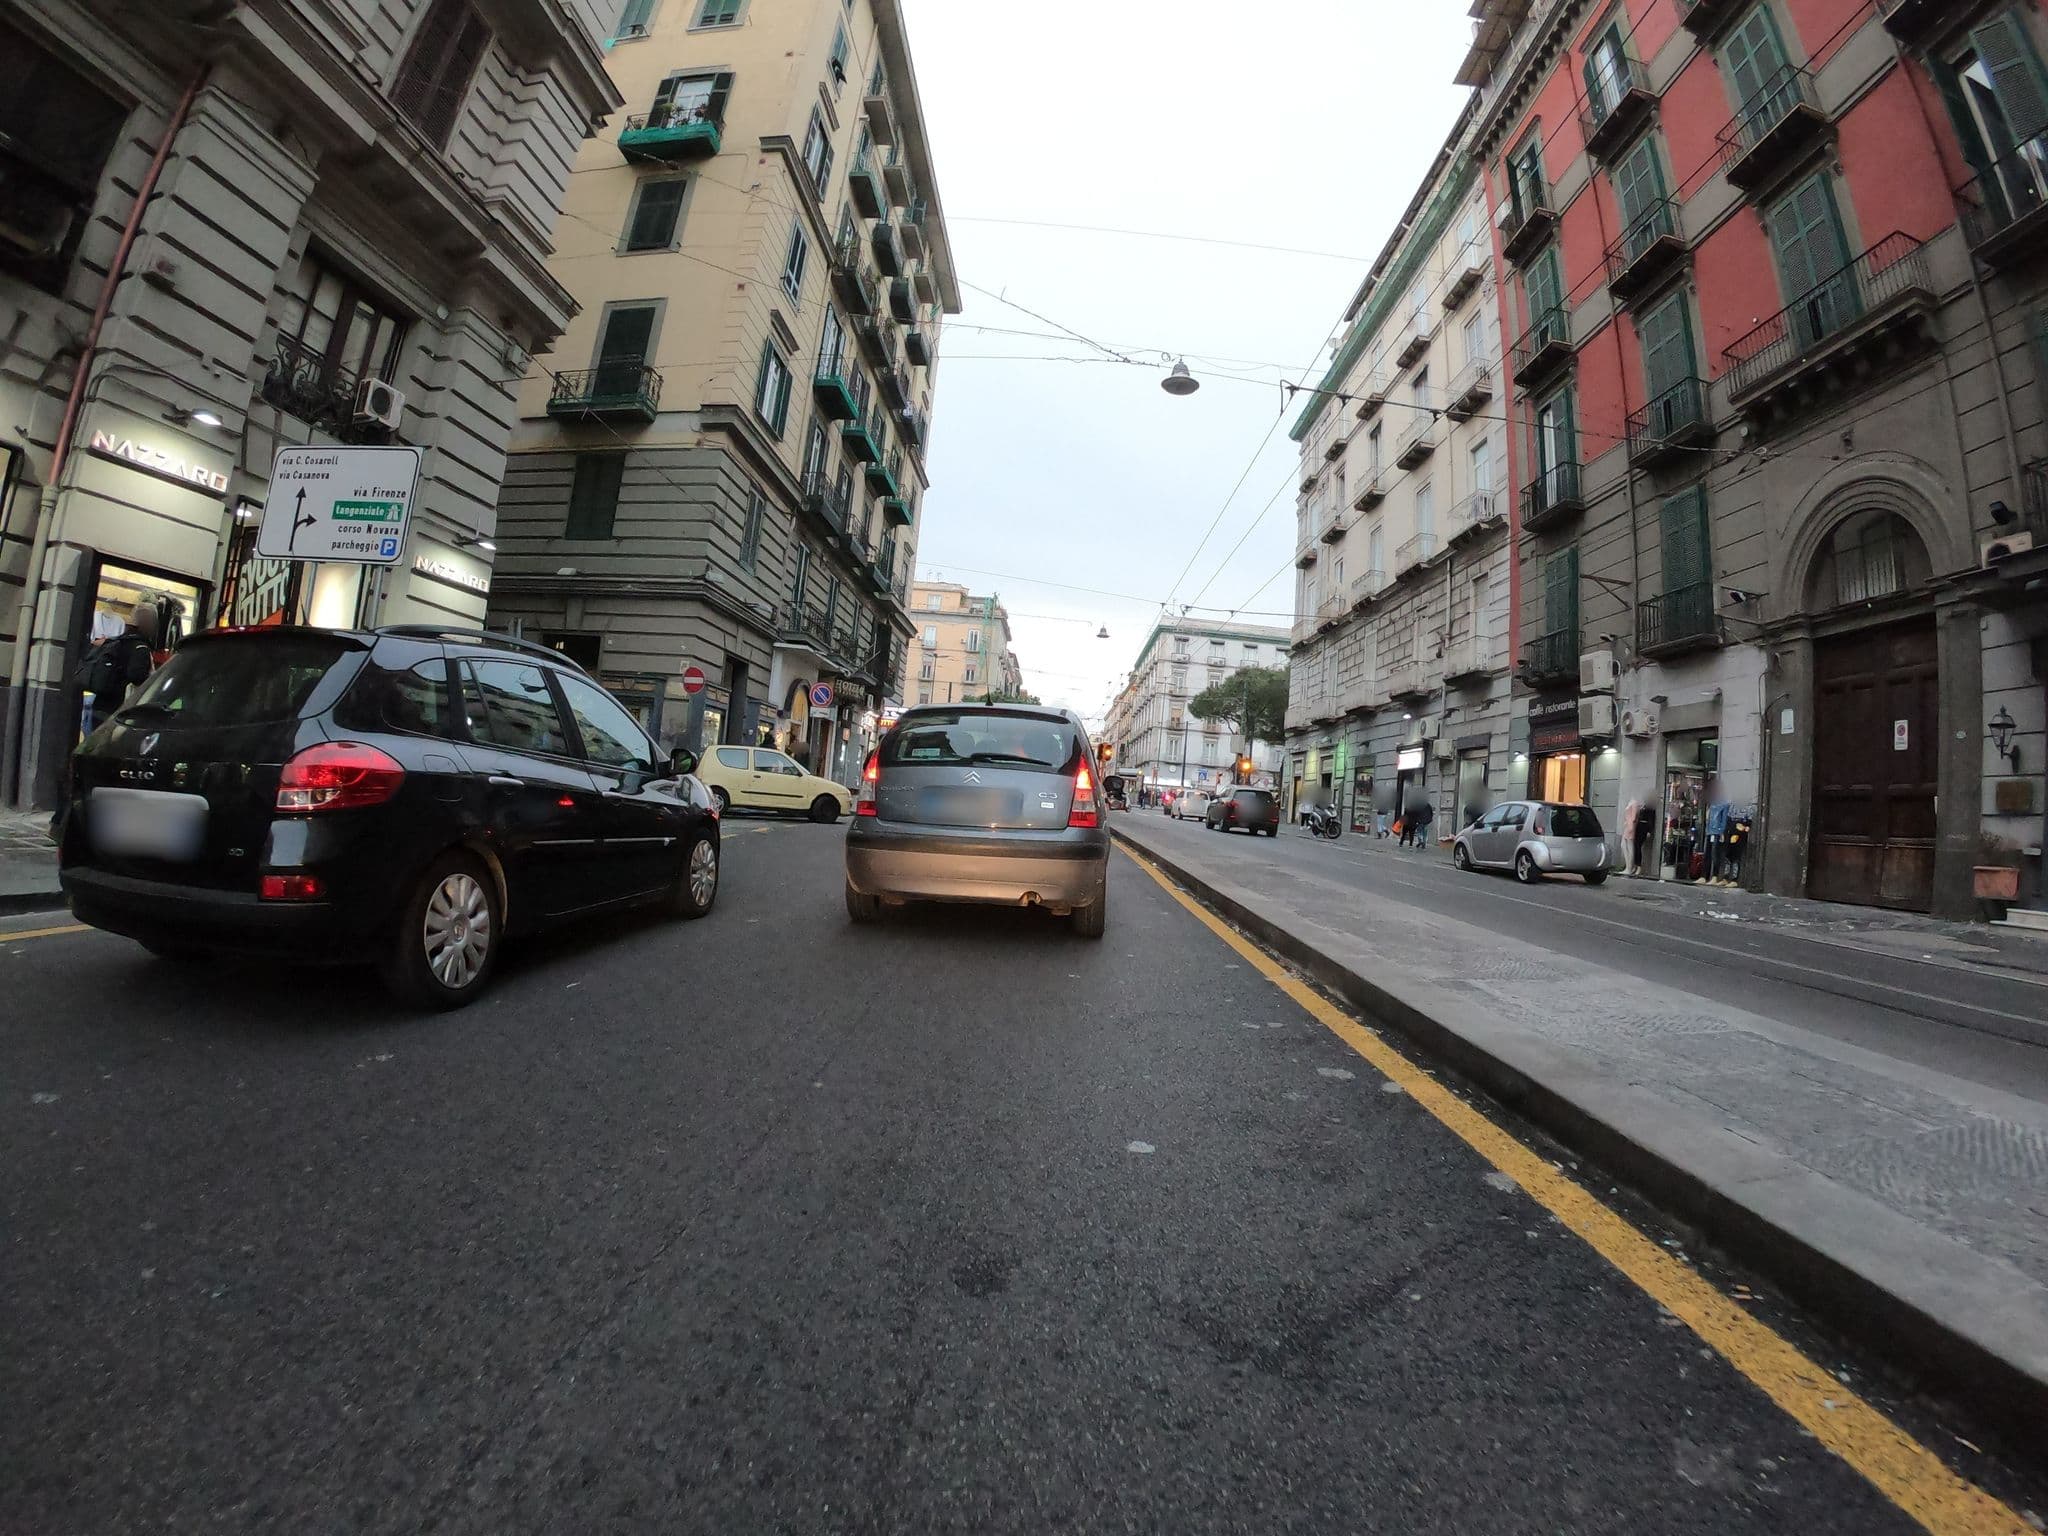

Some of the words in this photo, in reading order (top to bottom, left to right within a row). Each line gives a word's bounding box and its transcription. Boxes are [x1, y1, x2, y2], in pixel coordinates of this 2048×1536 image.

[90, 429, 228, 492] NAZZARO
[282, 456, 293, 465] via
[279, 470, 290, 479] via
[293, 470, 330, 479] Casanova
[353, 486, 367, 497] via
[372, 486, 407, 498] Firenze
[335, 505, 385, 517] tangenziale
[338, 525, 362, 534] corso
[366, 524, 399, 535] Novara
[331, 540, 379, 553] parcheggio
[383, 541, 394, 554] P
